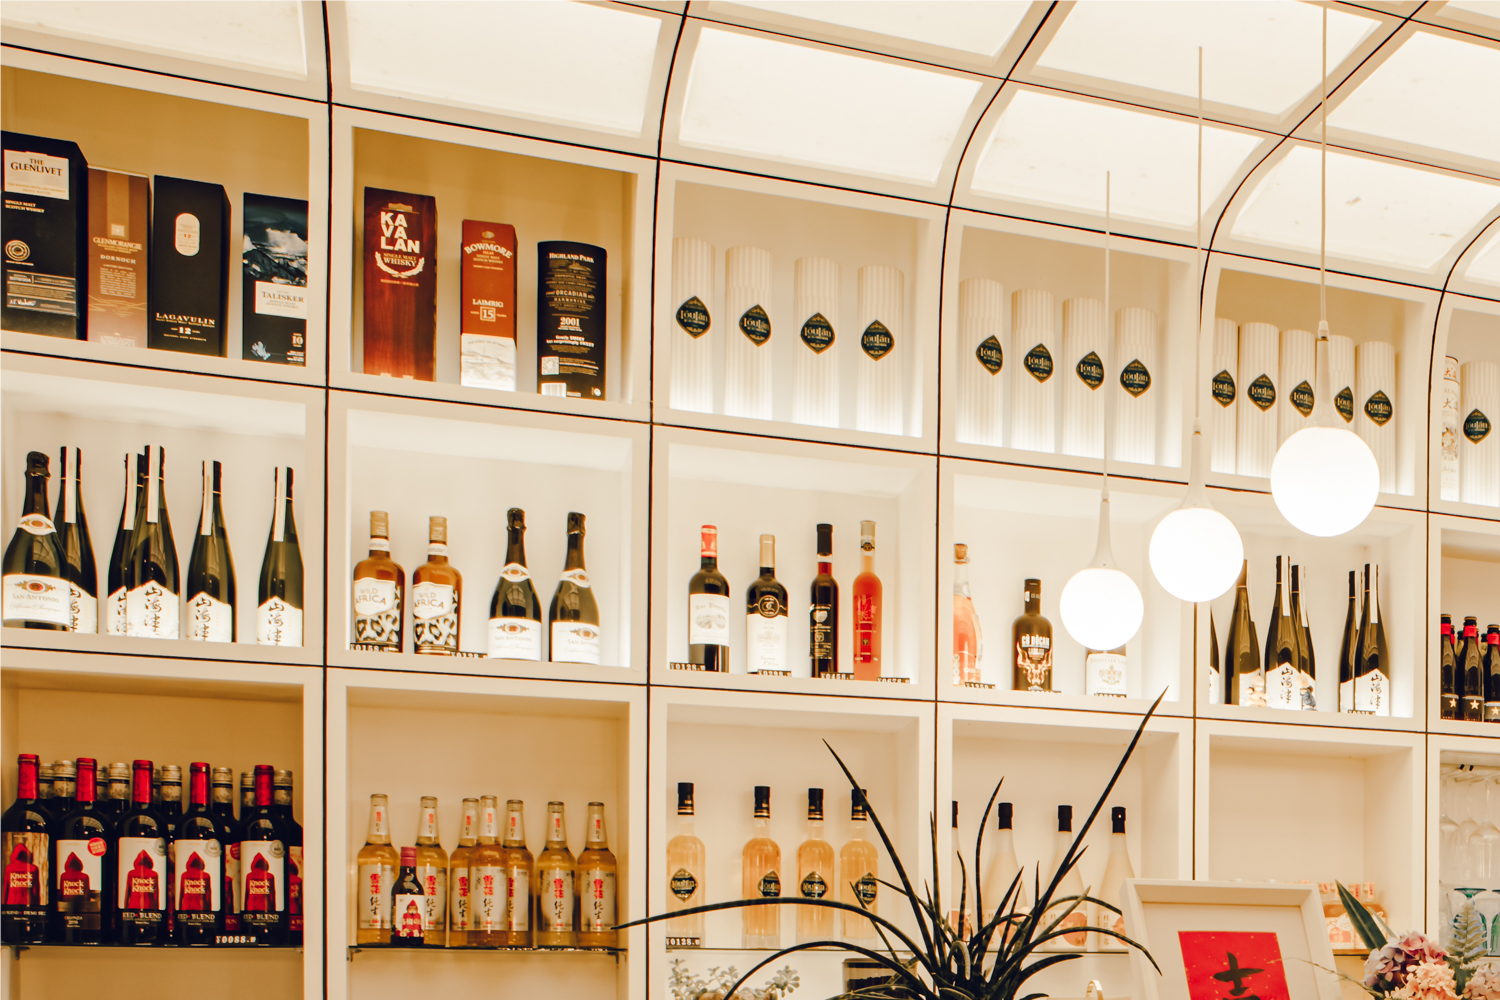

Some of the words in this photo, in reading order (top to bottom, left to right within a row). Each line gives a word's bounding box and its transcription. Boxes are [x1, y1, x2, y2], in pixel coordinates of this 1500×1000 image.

[30, 158, 45, 166] THE
[10, 161, 63, 177] GLENLIVET
[464, 243, 513, 259] BOWMORE
[100, 254, 137, 264] DORNOCH
[383, 257, 418, 267] WHISKY
[261, 291, 305, 303] TALISKER
[156, 313, 216, 325] LAGAVULIN
[482, 309, 495, 320] 15
[560, 316, 580, 327] 2001
[178, 327, 192, 335] 12
[359, 588, 379, 596] WILD
[417, 591, 437, 599] WILD
[355, 593, 387, 605] AFRICA
[414, 598, 445, 609] AFRICA
[10, 872, 33, 880] Knock
[132, 876, 155, 885] Knock
[10, 879, 33, 888] Knock
[63, 880, 85, 888] Knock
[184, 878, 206, 886] Knock
[249, 879, 270, 887] Knock
[63, 887, 85, 896] Knock
[132, 885, 155, 893] Knock
[184, 886, 206, 895] Knock
[249, 886, 270, 895] Knock
[192, 913, 215, 921] BLEND
